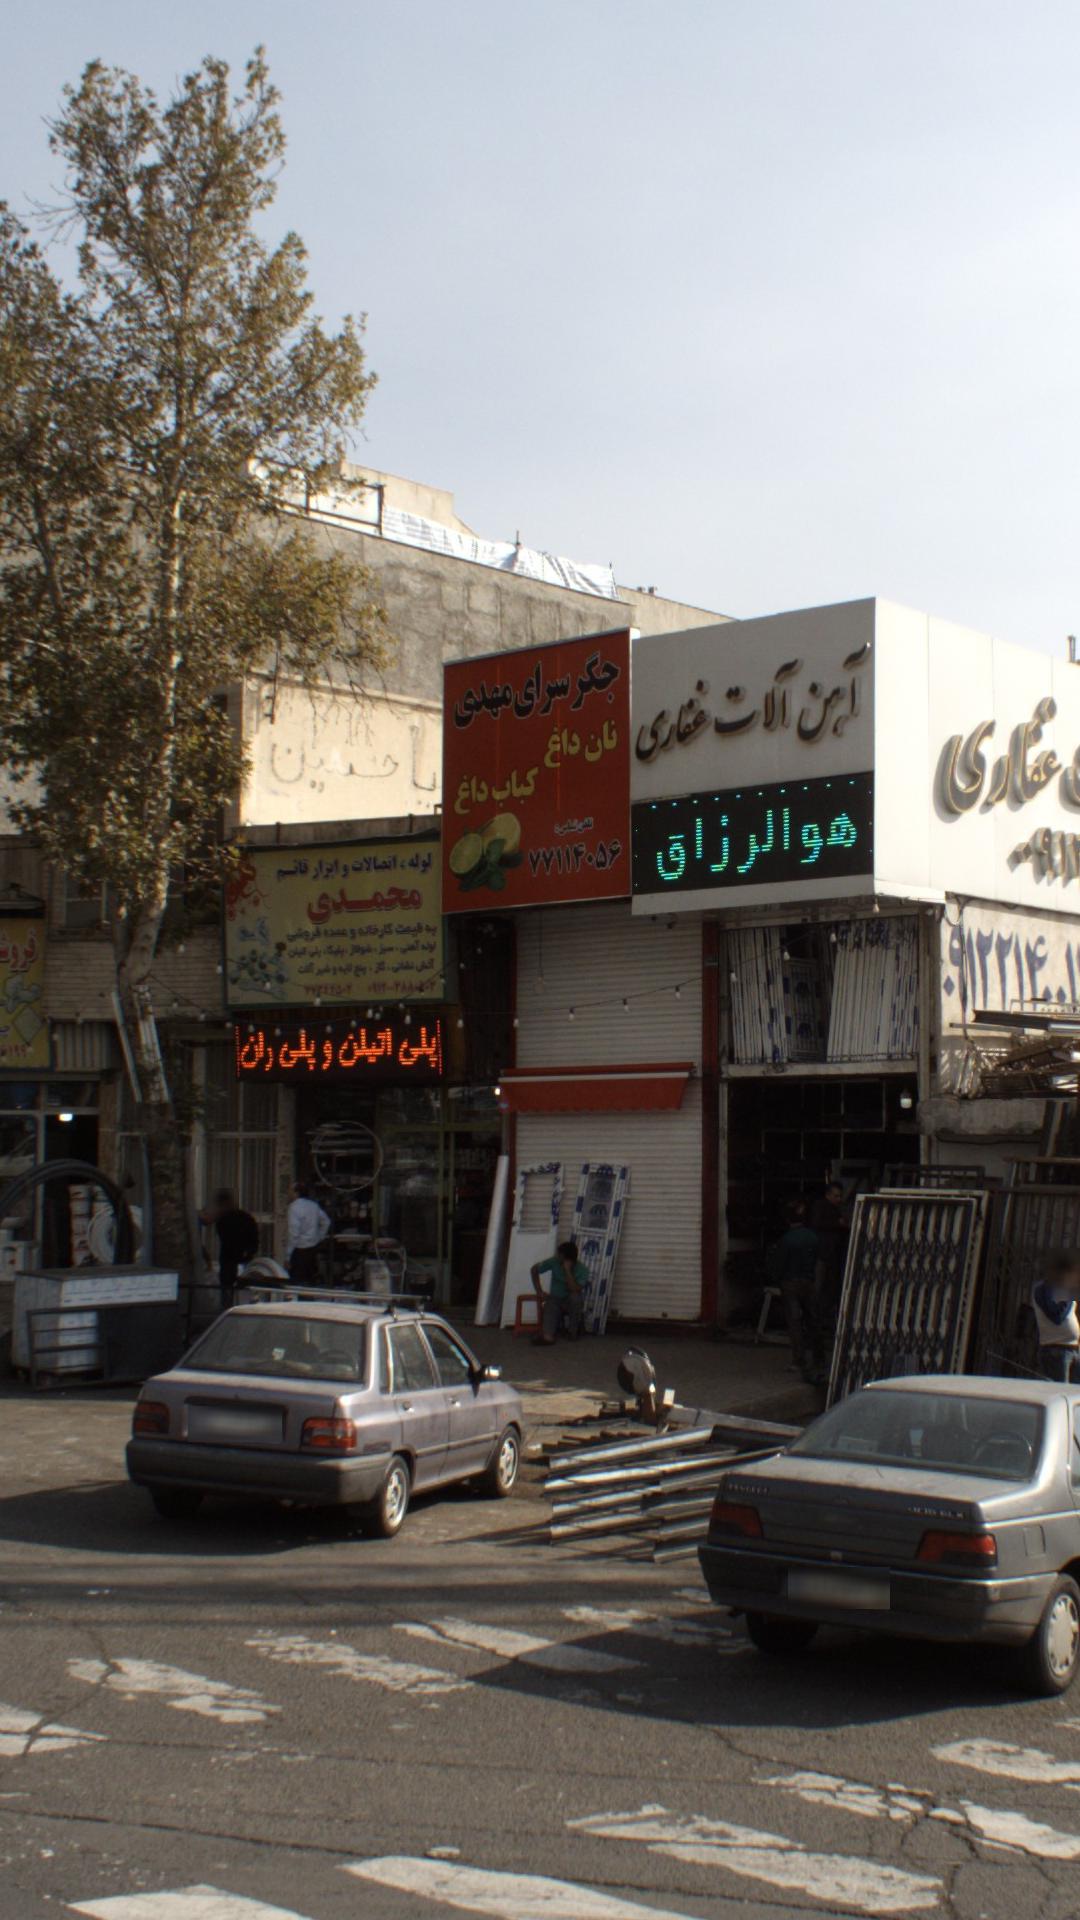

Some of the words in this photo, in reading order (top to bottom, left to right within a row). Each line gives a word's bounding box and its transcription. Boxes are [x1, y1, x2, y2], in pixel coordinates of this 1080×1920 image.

[453, 680, 515, 730] مهدی
[797, 642, 871, 743] آهن
[584, 720, 619, 763] نان
[635, 679, 711, 763] غفاری
[543, 725, 582, 768] داغ
[935, 697, 1062, 815] غفاری
[453, 773, 490, 815] داغ
[491, 766, 540, 807] کباب
[527, 839, 622, 878] ۷۷۱۱۴۰۵۶
[307, 886, 423, 925] محمدی
[278, 1028, 316, 1071] پلی
[322, 1040, 333, 1070] و
[339, 1027, 392, 1067] اتیلن
[399, 1026, 438, 1068] پلی
